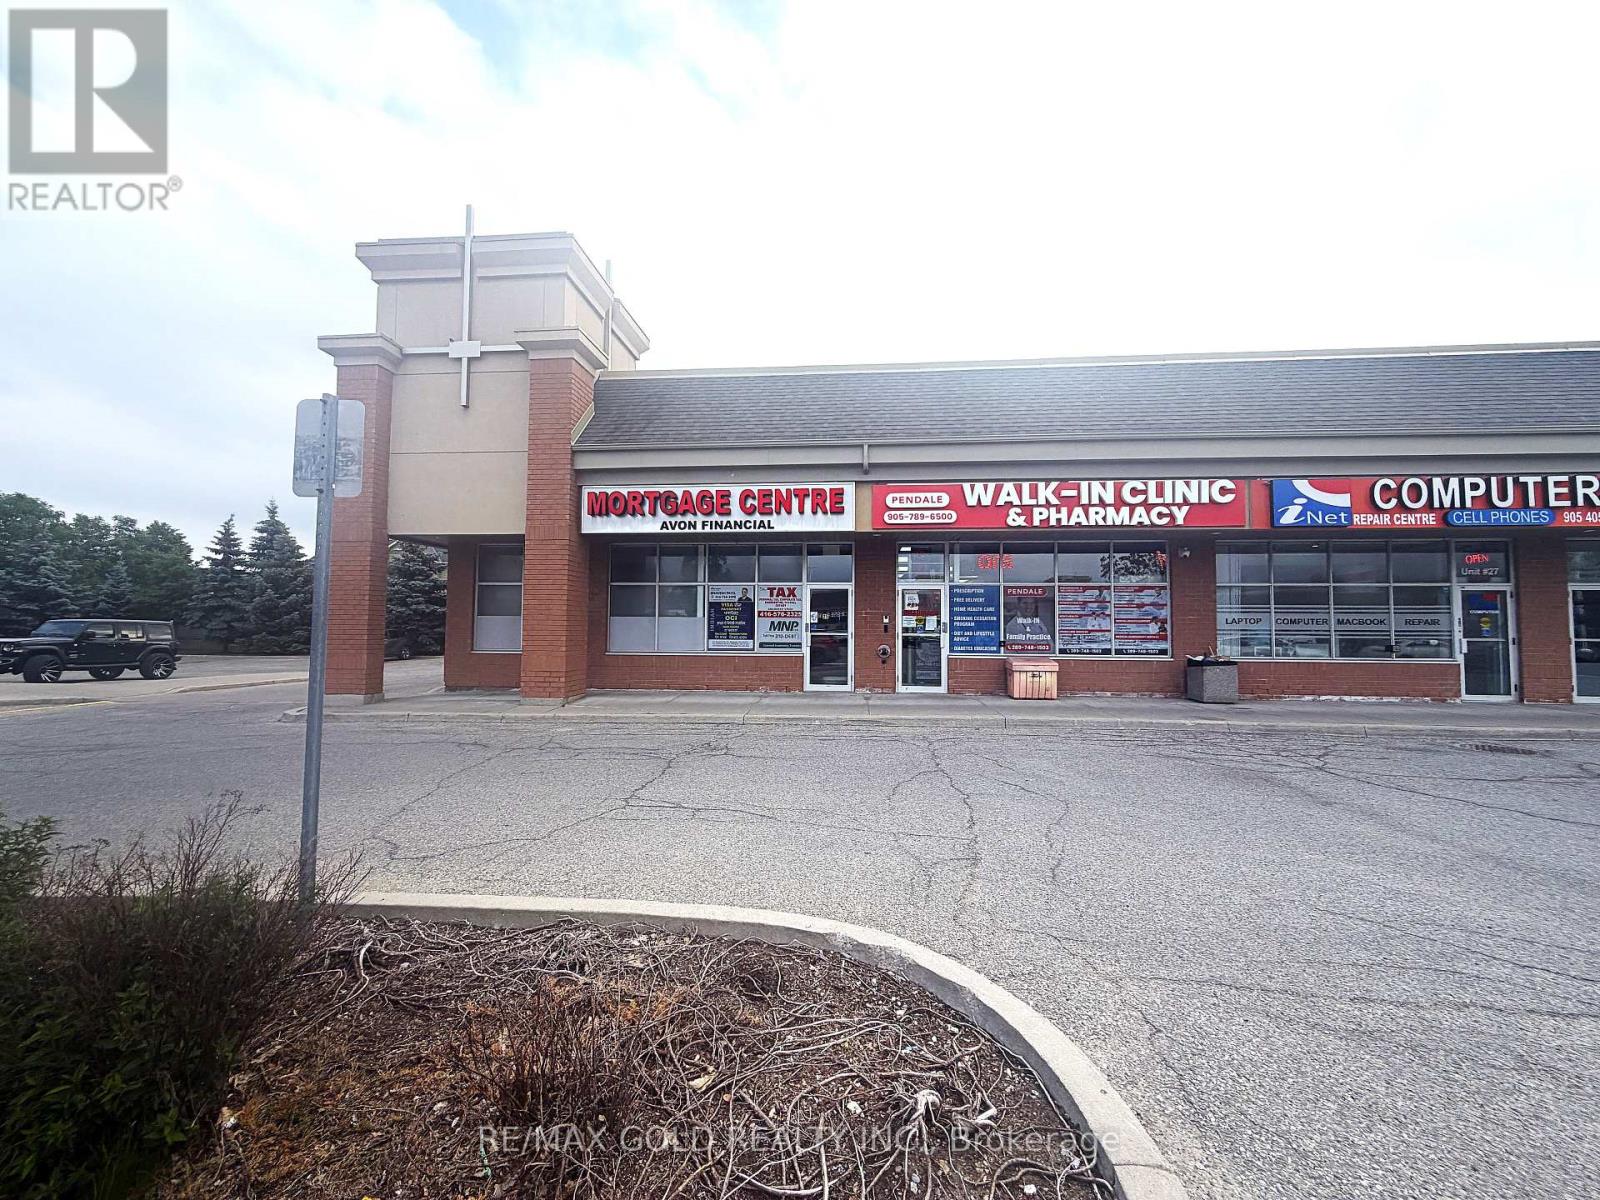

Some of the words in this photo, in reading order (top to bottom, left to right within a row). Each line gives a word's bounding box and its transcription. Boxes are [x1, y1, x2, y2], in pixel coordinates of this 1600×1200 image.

[960, 480, 1115, 507] WALK-IN
[1121, 478, 1237, 505] CLINIC
[1373, 475, 1600, 510] COMPUTER
[586, 489, 733, 518] MORTGAGE
[738, 487, 846, 516] CENTRE
[891, 495, 944, 505] PENDALE
[887, 512, 953, 521] 905-789-6500
[1005, 506, 1029, 527] &
[1031, 505, 1191, 527] PHARMACY
[1353, 513, 1391, 525] REPAIR
[1393, 513, 1437, 525] CENTRE
[1453, 511, 1488, 524] CELL
[1491, 510, 1550, 524] PHONES
[1563, 511, 1583, 523] 905
[1585, 511, 1600, 523] 40
[660, 520, 697, 531] AVON
[701, 519, 775, 531] FINANCIAL
[1464, 552, 1489, 565] OPEN
[1461, 567, 1481, 576] Unit
[1482, 567, 1499, 576] #27
[767, 586, 798, 598] TAX
[769, 621, 799, 632] MNP
[1225, 617, 1263, 625] LAPTOP
[1275, 617, 1329, 626] COMPUTER
[1336, 618, 1387, 626] MACBOOK
[1404, 618, 1441, 626] REPAIR
[1006, 633, 1026, 641] Family
